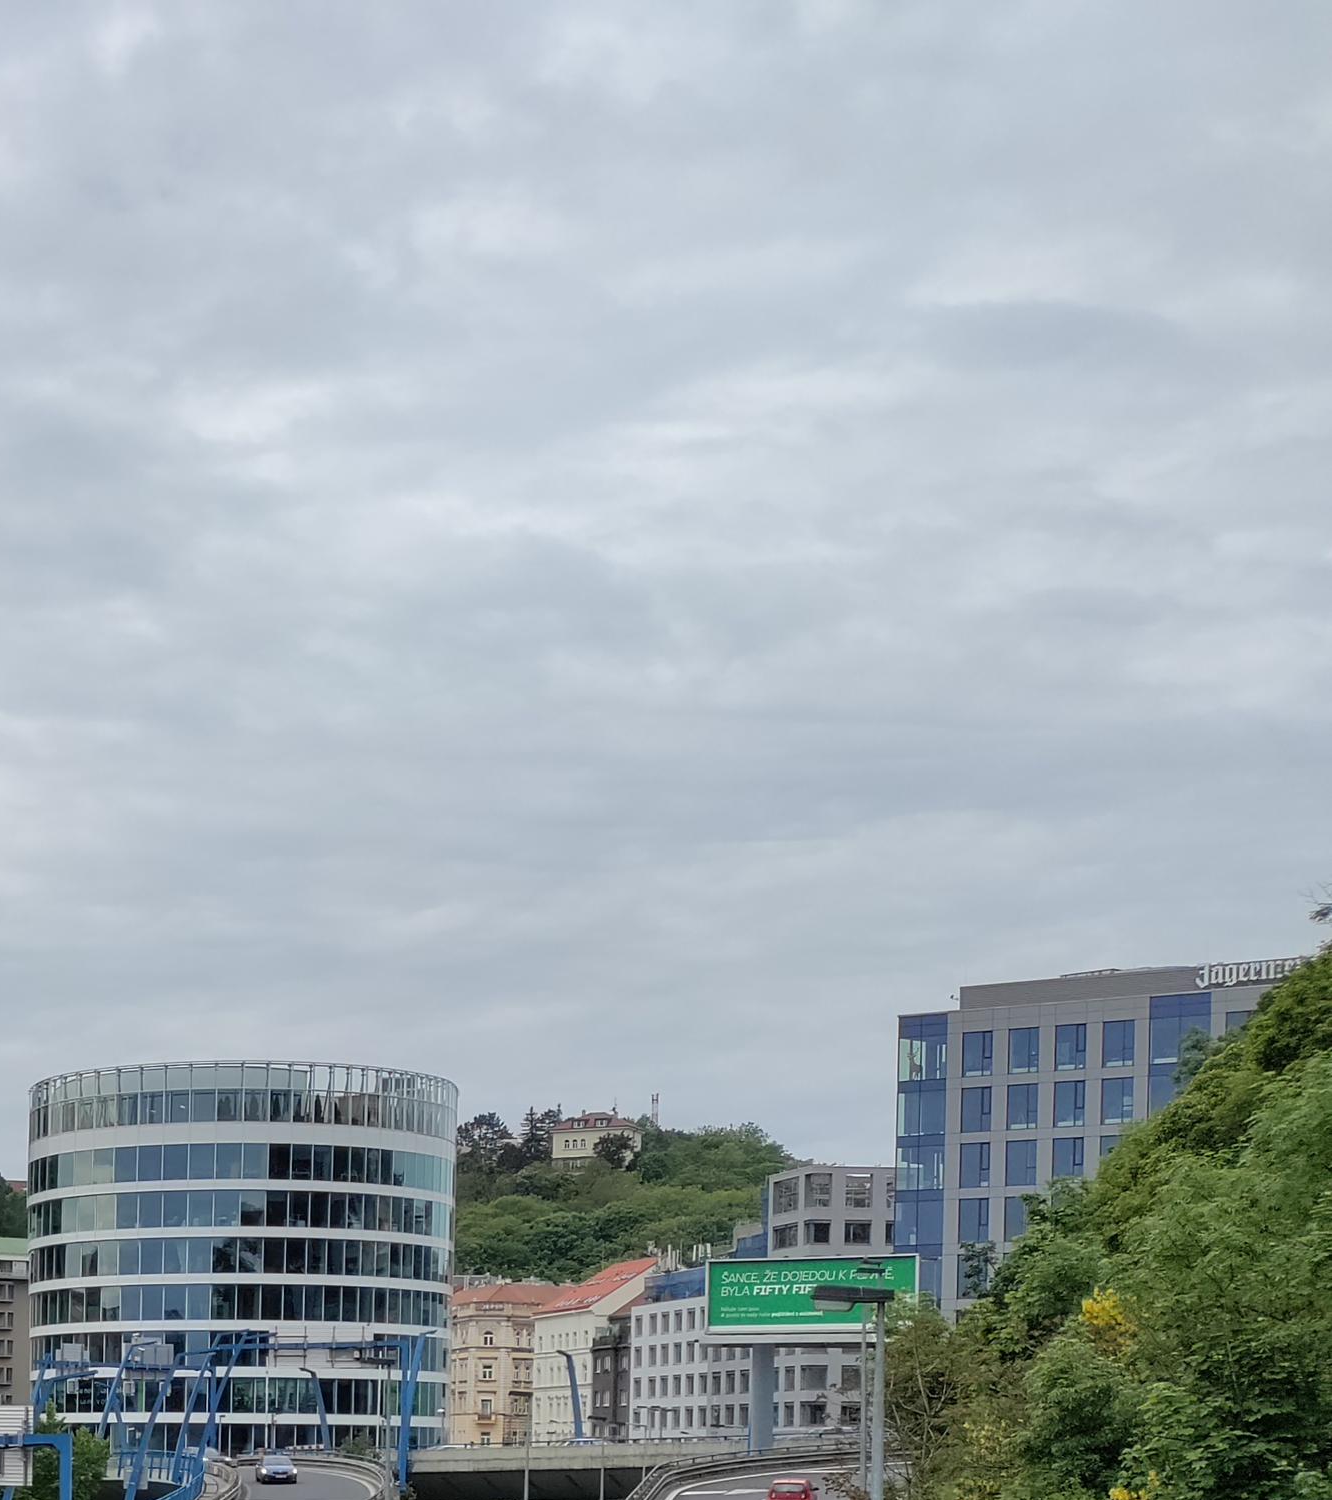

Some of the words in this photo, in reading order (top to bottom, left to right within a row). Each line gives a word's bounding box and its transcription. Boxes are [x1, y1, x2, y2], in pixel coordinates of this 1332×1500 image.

[721, 1271, 760, 1284] ŠANCE,
[763, 1270, 779, 1283] ŽE
[781, 1270, 836, 1283] DOJEDOU
[838, 1270, 847, 1280] K
[721, 1286, 750, 1296] BYLA
[753, 1285, 790, 1296] FIFTY
